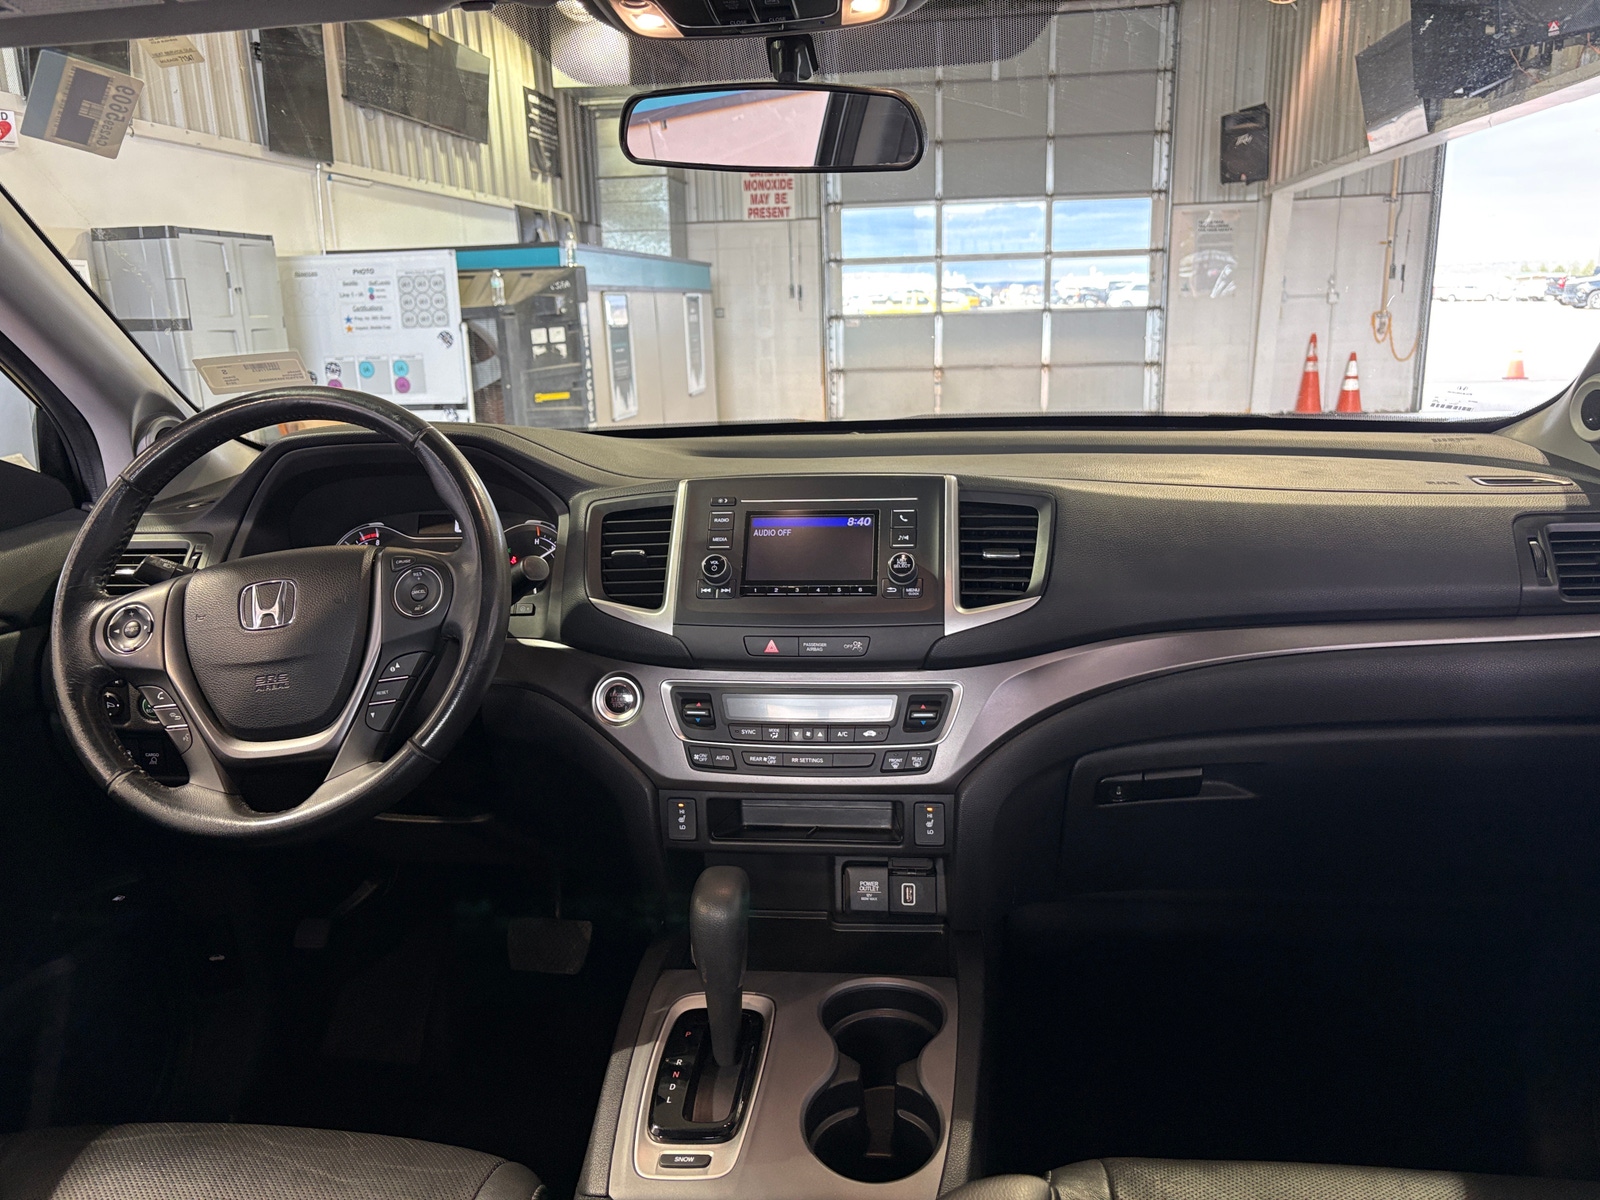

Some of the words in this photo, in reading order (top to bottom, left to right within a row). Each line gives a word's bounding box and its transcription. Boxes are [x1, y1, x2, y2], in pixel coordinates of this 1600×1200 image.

[743, 178, 794, 191] MONOXIDE
[750, 193, 770, 205] MAY
[774, 192, 788, 205] BE
[747, 206, 791, 219] PRESENT
[847, 516, 872, 527] 8:40
[753, 528, 777, 537] AUDIO
[777, 528, 792, 537] OFF
[254, 673, 288, 684] SRS
[741, 728, 757, 736] SYNC
[684, 1030, 692, 1038] P
[676, 1058, 683, 1066] R
[672, 1070, 681, 1078] N
[669, 1083, 676, 1091] D
[666, 1096, 672, 1104] L
[673, 1155, 695, 1163] SNOW
